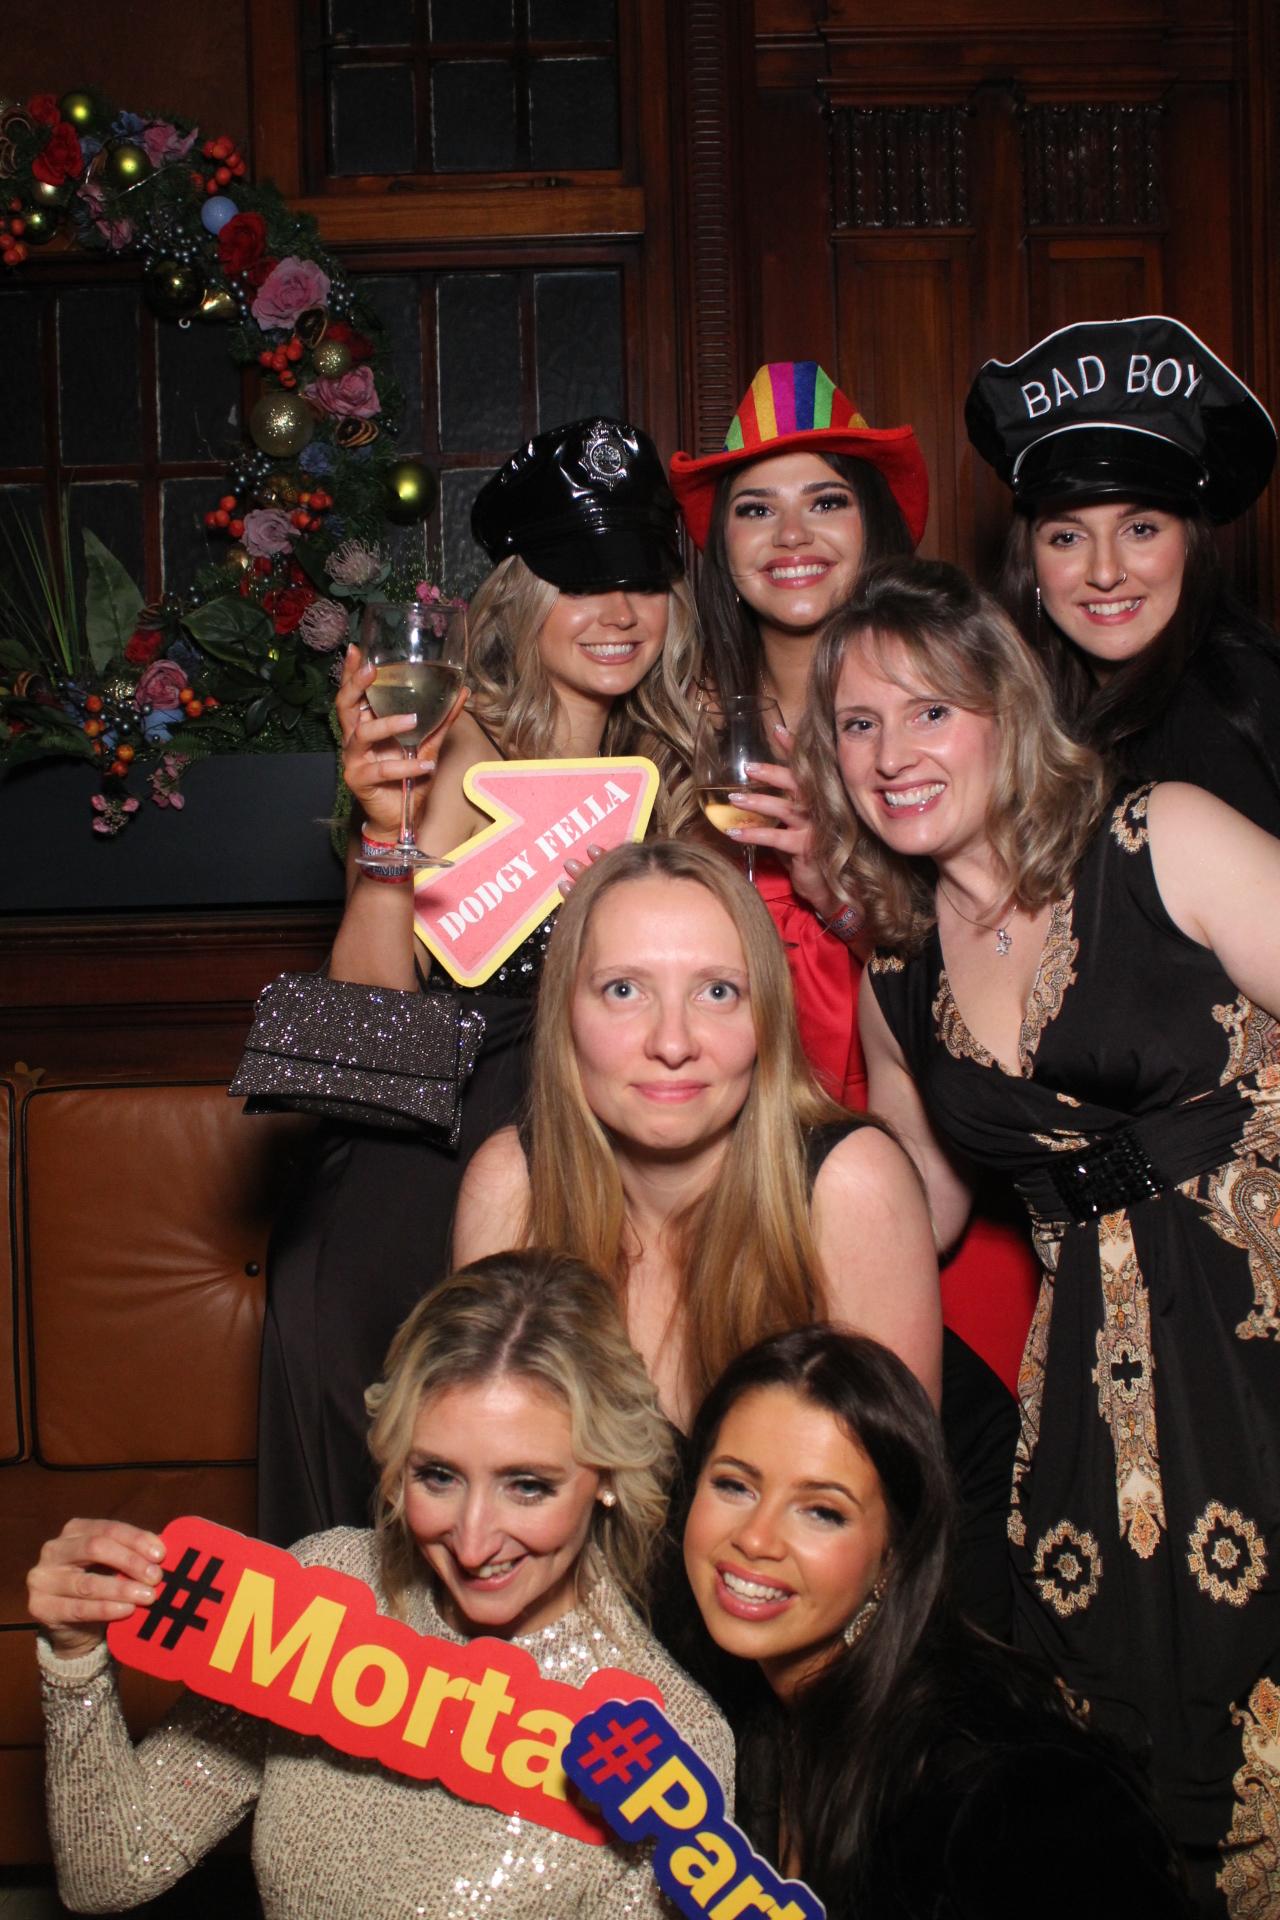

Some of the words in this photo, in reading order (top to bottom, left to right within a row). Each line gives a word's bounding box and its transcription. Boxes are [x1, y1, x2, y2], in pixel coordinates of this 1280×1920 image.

[1021, 355, 1106, 418] BAD
[1126, 354, 1202, 398] BOY
[436, 850, 538, 942] DODGY
[534, 780, 631, 862] FELLA
[137, 1546, 602, 1814] #Morta
